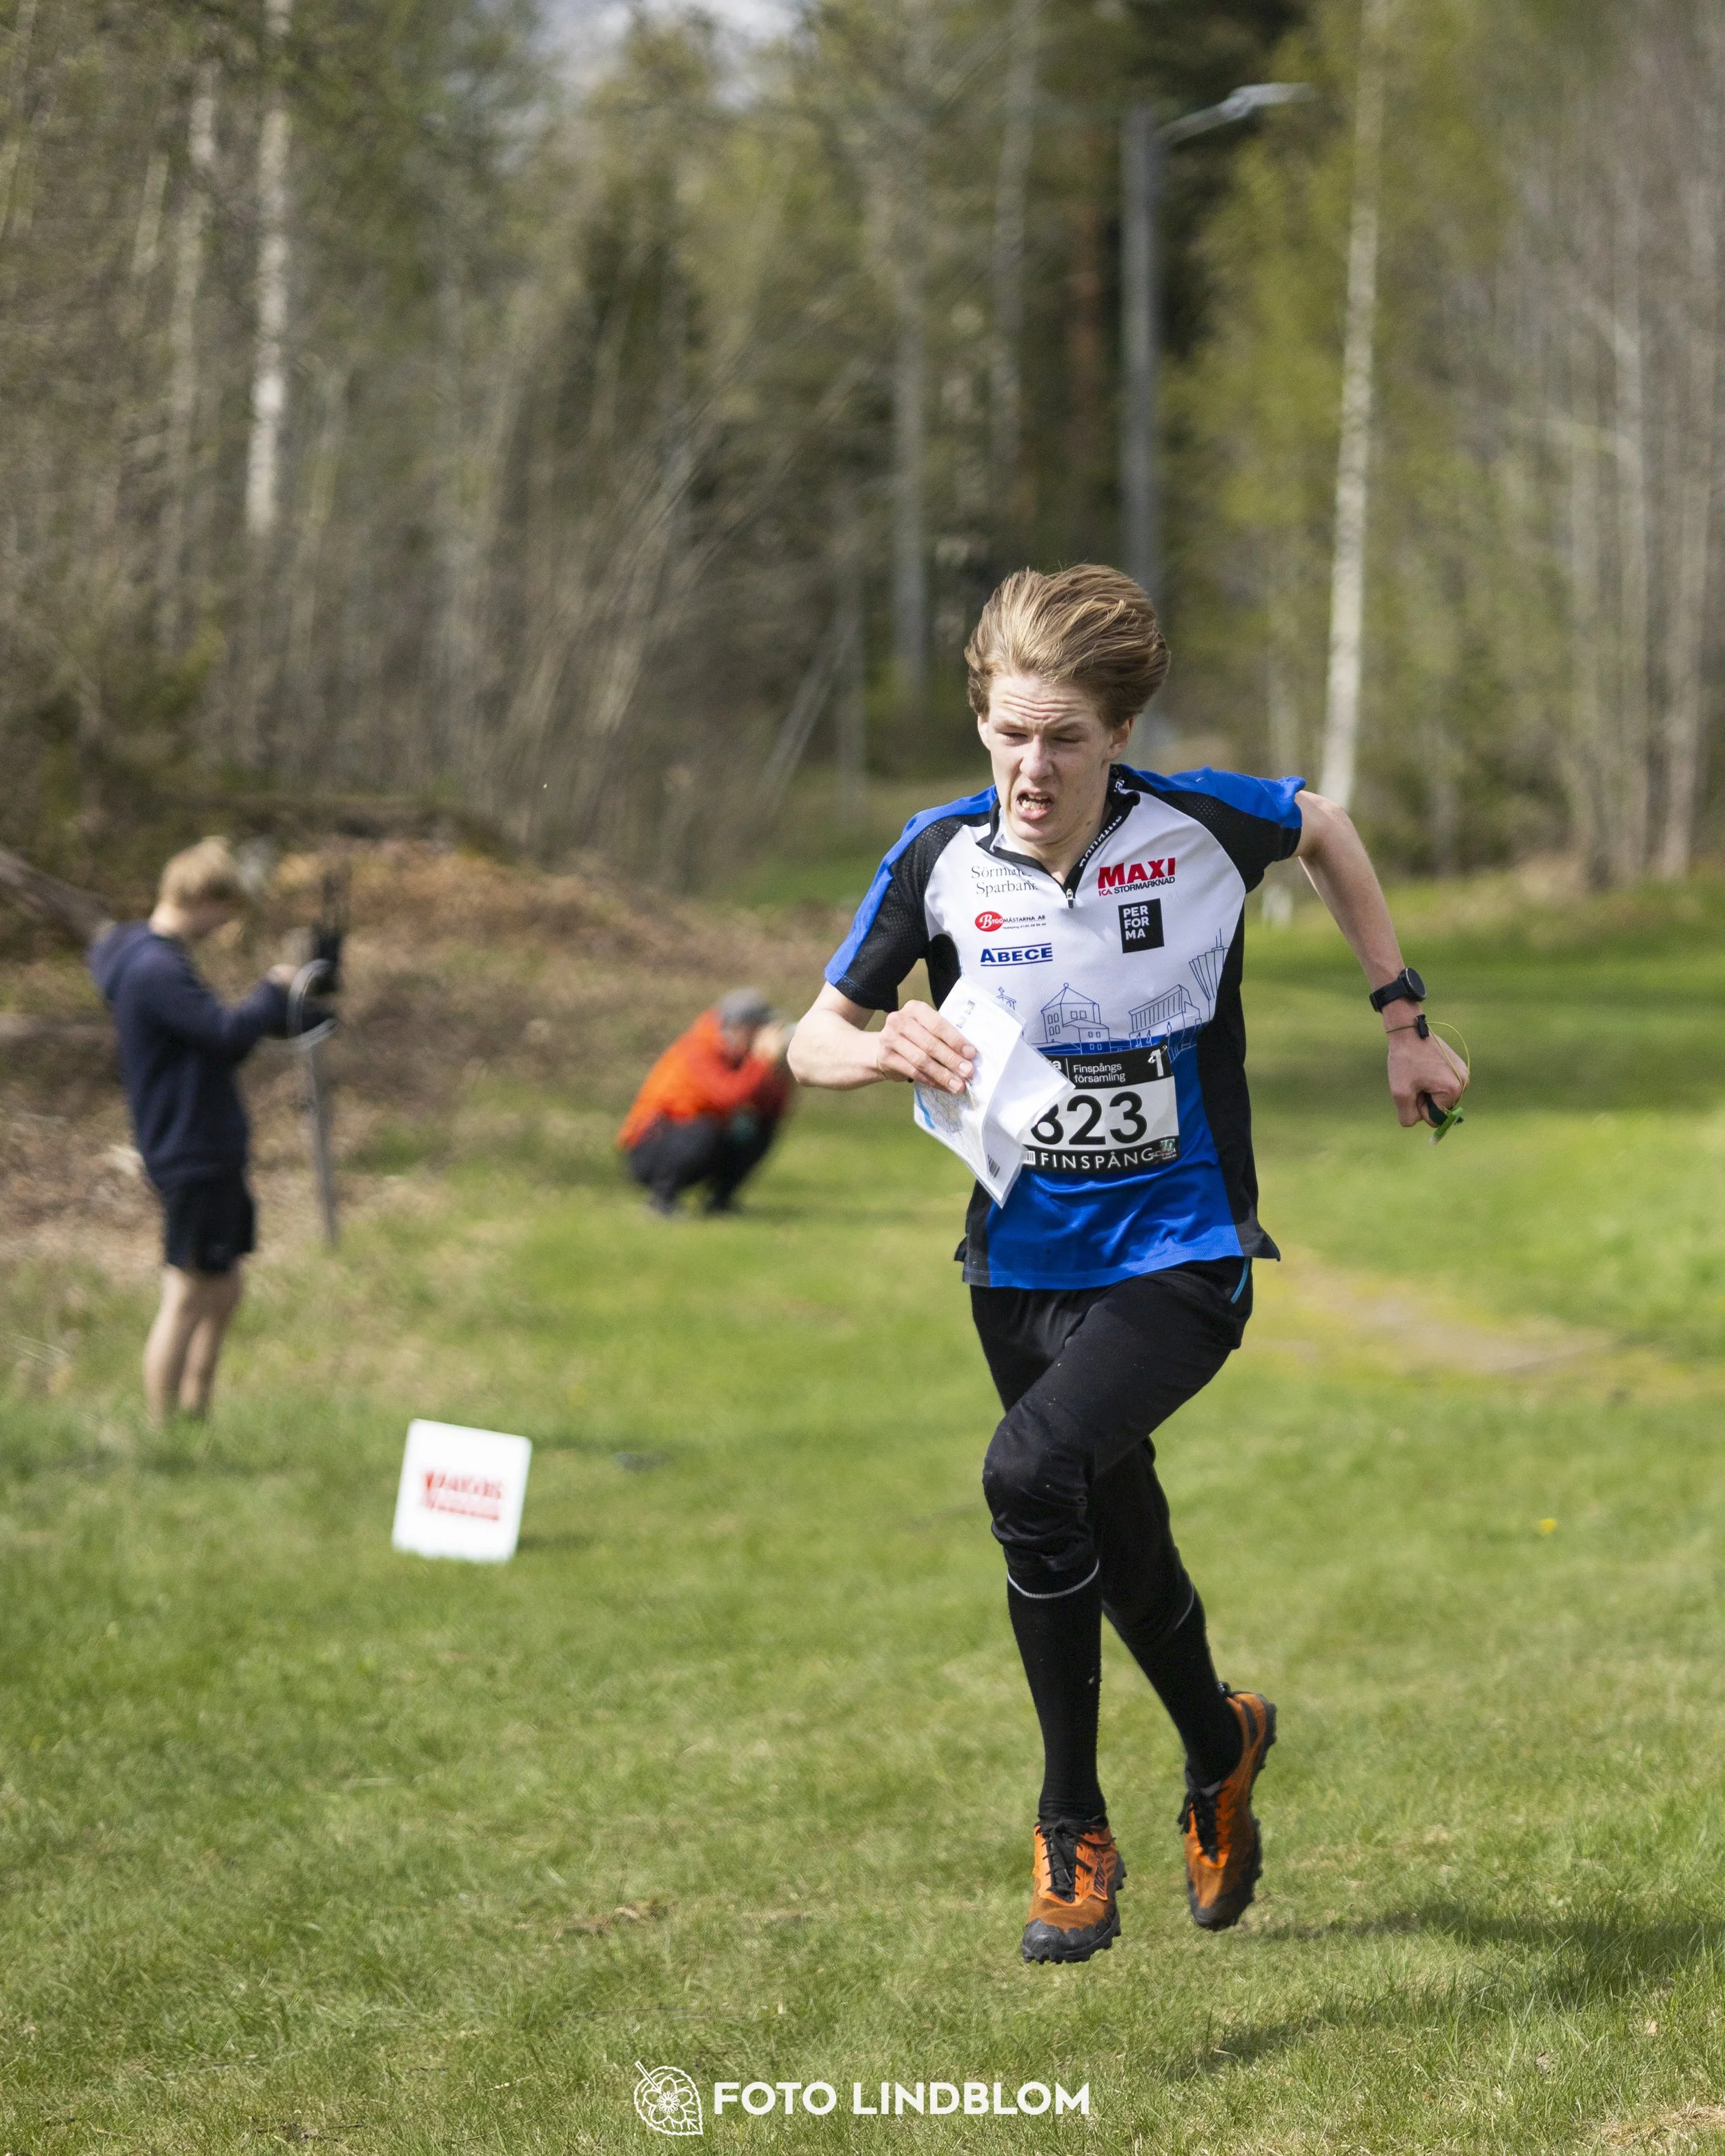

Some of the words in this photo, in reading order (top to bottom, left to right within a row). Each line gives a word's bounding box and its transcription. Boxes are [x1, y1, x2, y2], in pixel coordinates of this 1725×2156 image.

[1098, 858, 1175, 889] MAXI
[1114, 877, 1175, 894] STORMARKNAD
[1123, 905, 1148, 918] PER
[1124, 916, 1150, 929] FOR
[1125, 928, 1145, 940] MA
[980, 947, 1053, 962] ABECE
[1073, 1062, 1122, 1074] Finspångs
[1074, 1072, 1125, 1083] församling
[1041, 1148, 1154, 1169] FINSPÅNG
